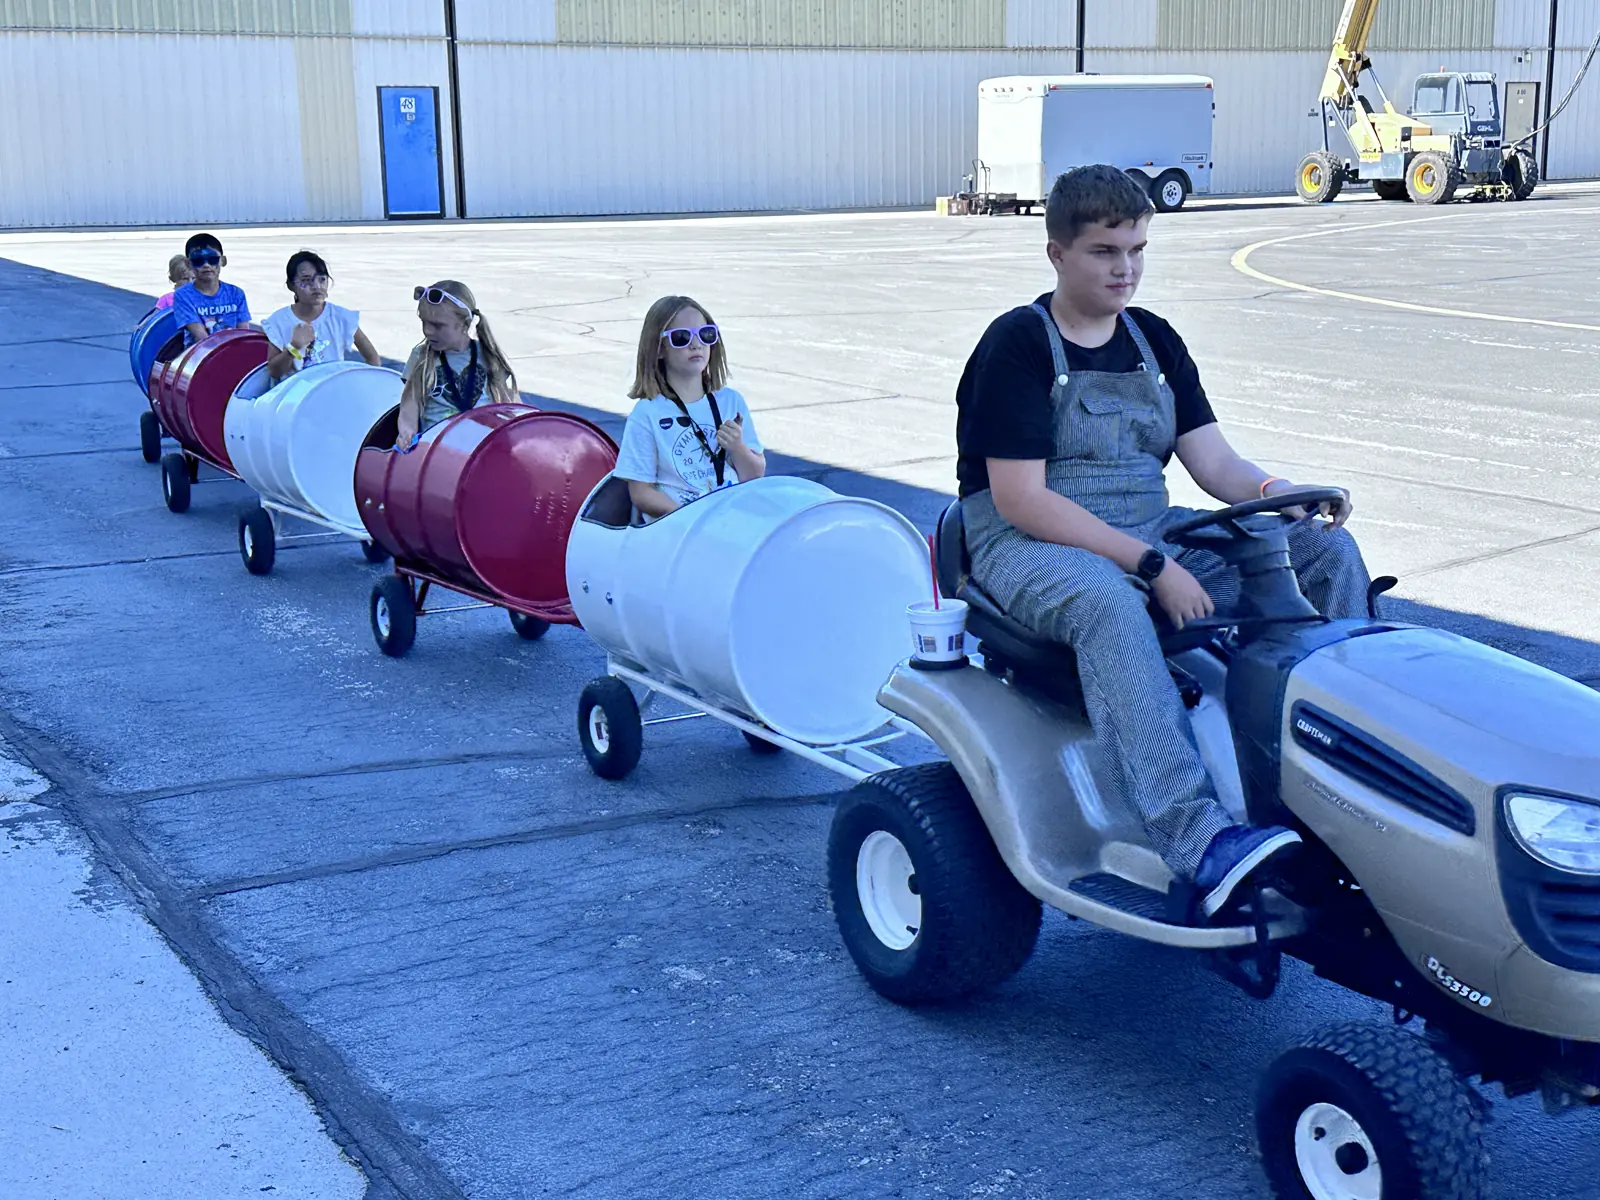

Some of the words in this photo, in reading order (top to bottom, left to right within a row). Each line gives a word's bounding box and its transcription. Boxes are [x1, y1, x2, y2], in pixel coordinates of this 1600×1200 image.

[401, 98, 413, 109] 48
[1296, 718, 1332, 745] CRAFTSMAN
[1427, 956, 1492, 1007] DLS3500
